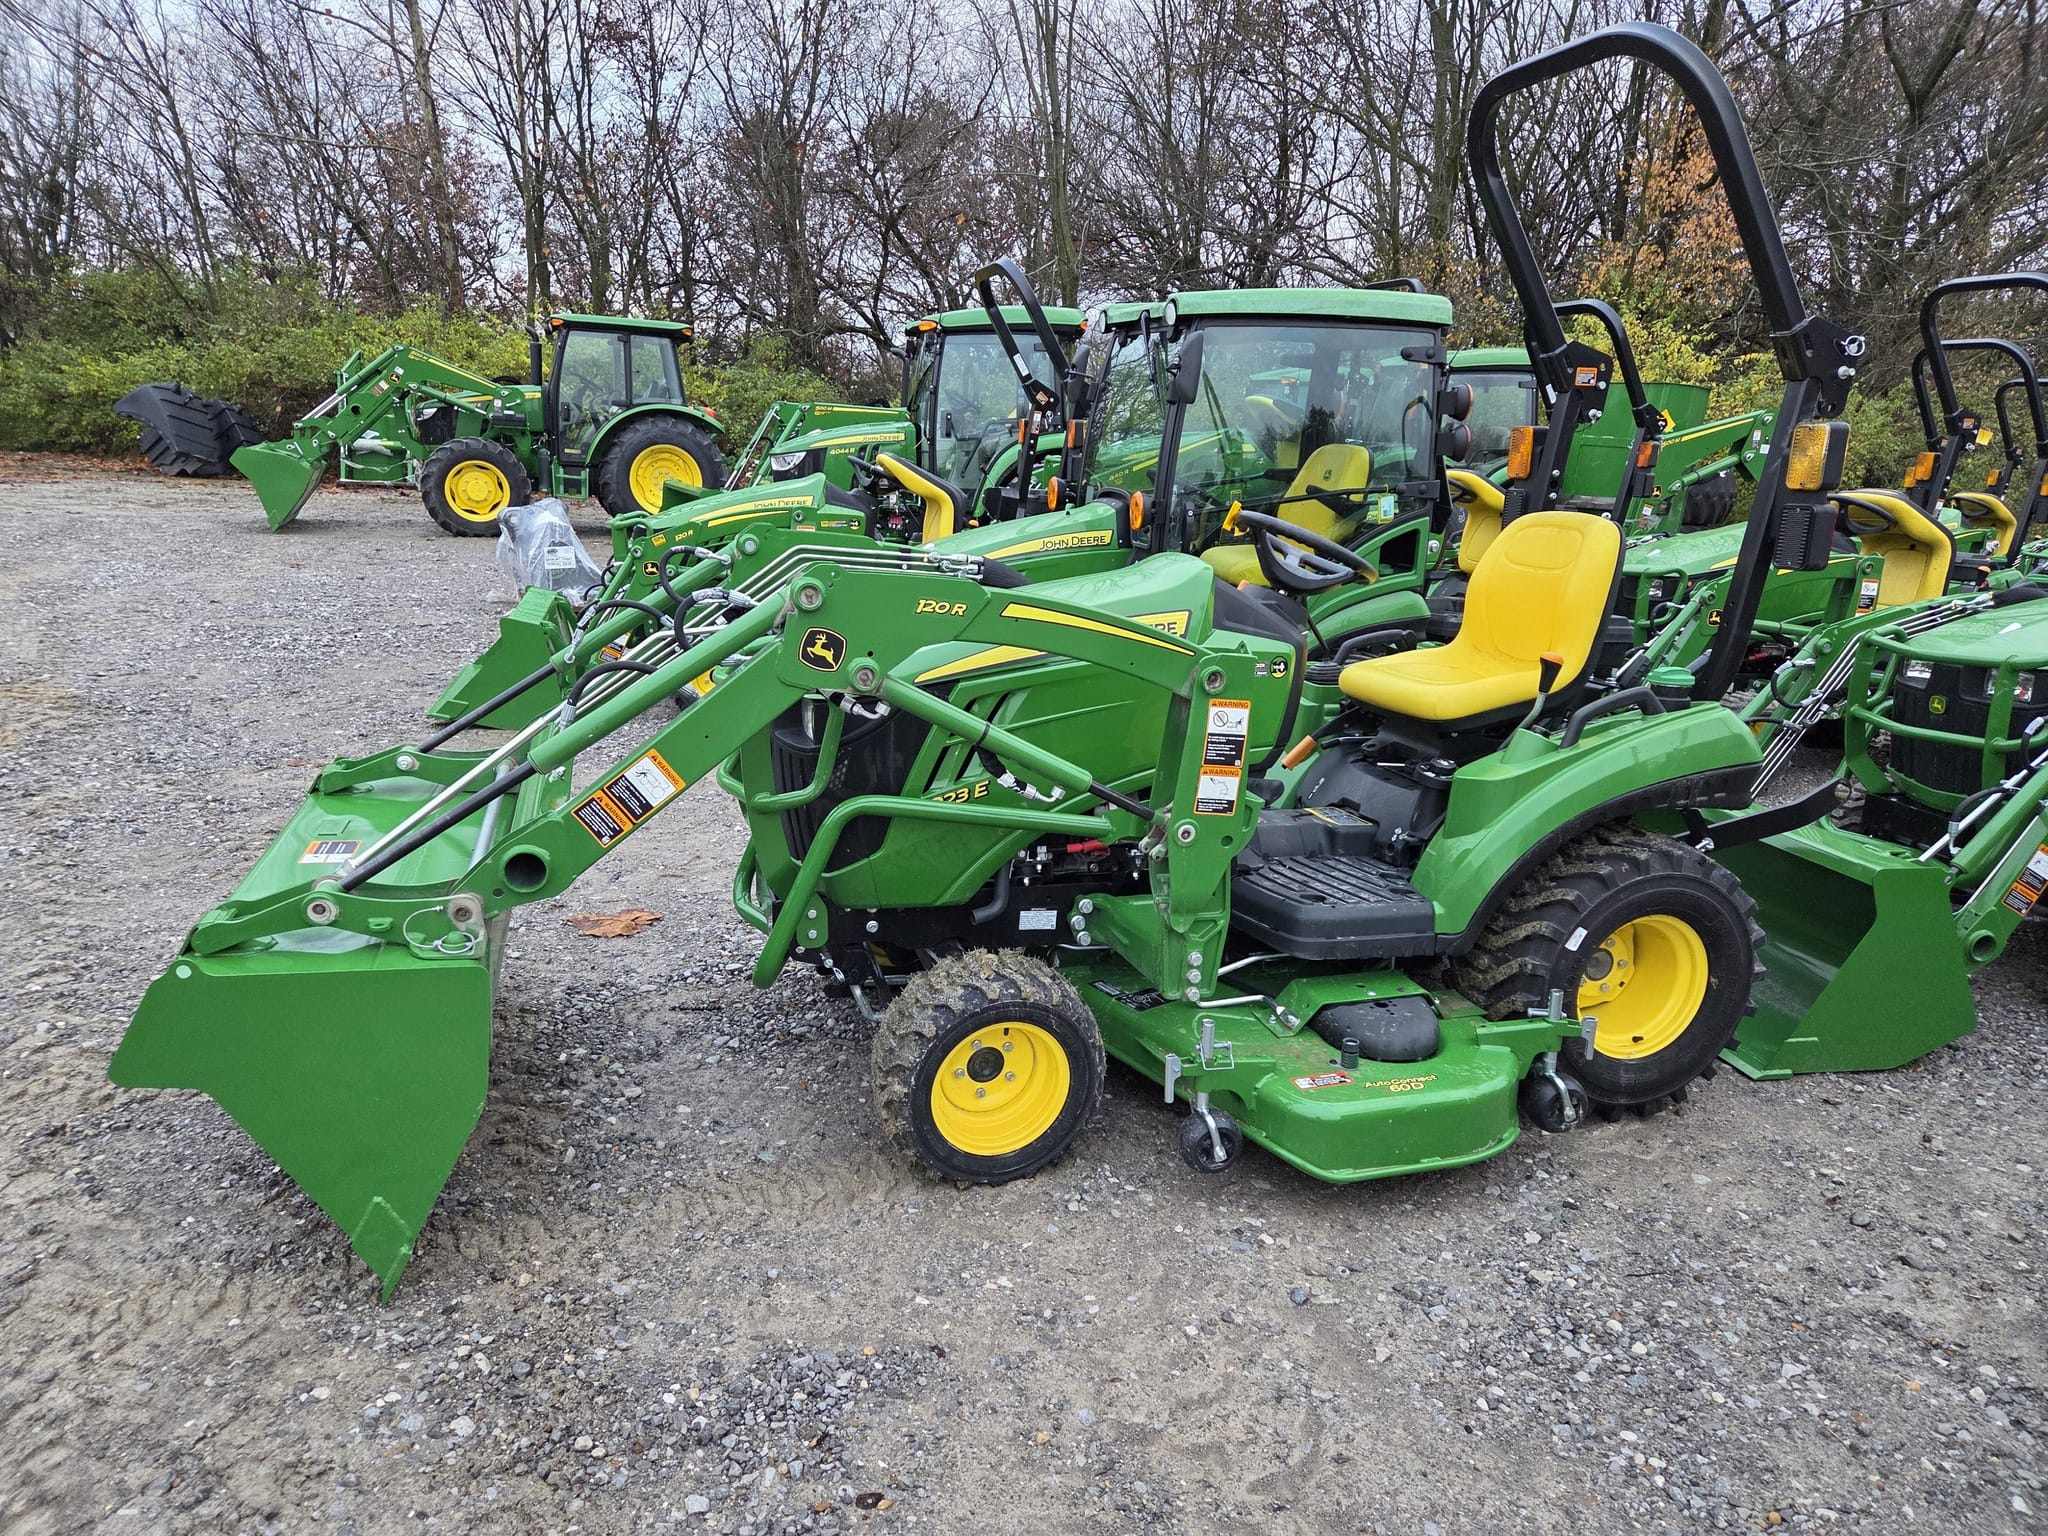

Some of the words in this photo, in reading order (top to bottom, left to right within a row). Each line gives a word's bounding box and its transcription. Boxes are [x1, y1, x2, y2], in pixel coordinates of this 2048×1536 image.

[830, 447, 849, 456] 4044
[1039, 538, 1069, 550] JOHN
[1071, 535, 1107, 547] DEERE
[915, 597, 951, 615] 120
[950, 602, 968, 617] R
[1217, 700, 1249, 709] WARNING
[656, 760, 680, 786] WARNING
[1208, 768, 1240, 777] WARNING
[973, 779, 991, 799] E
[603, 801, 627, 827] WARNING
[1364, 1074, 1438, 1088] AutoConnect
